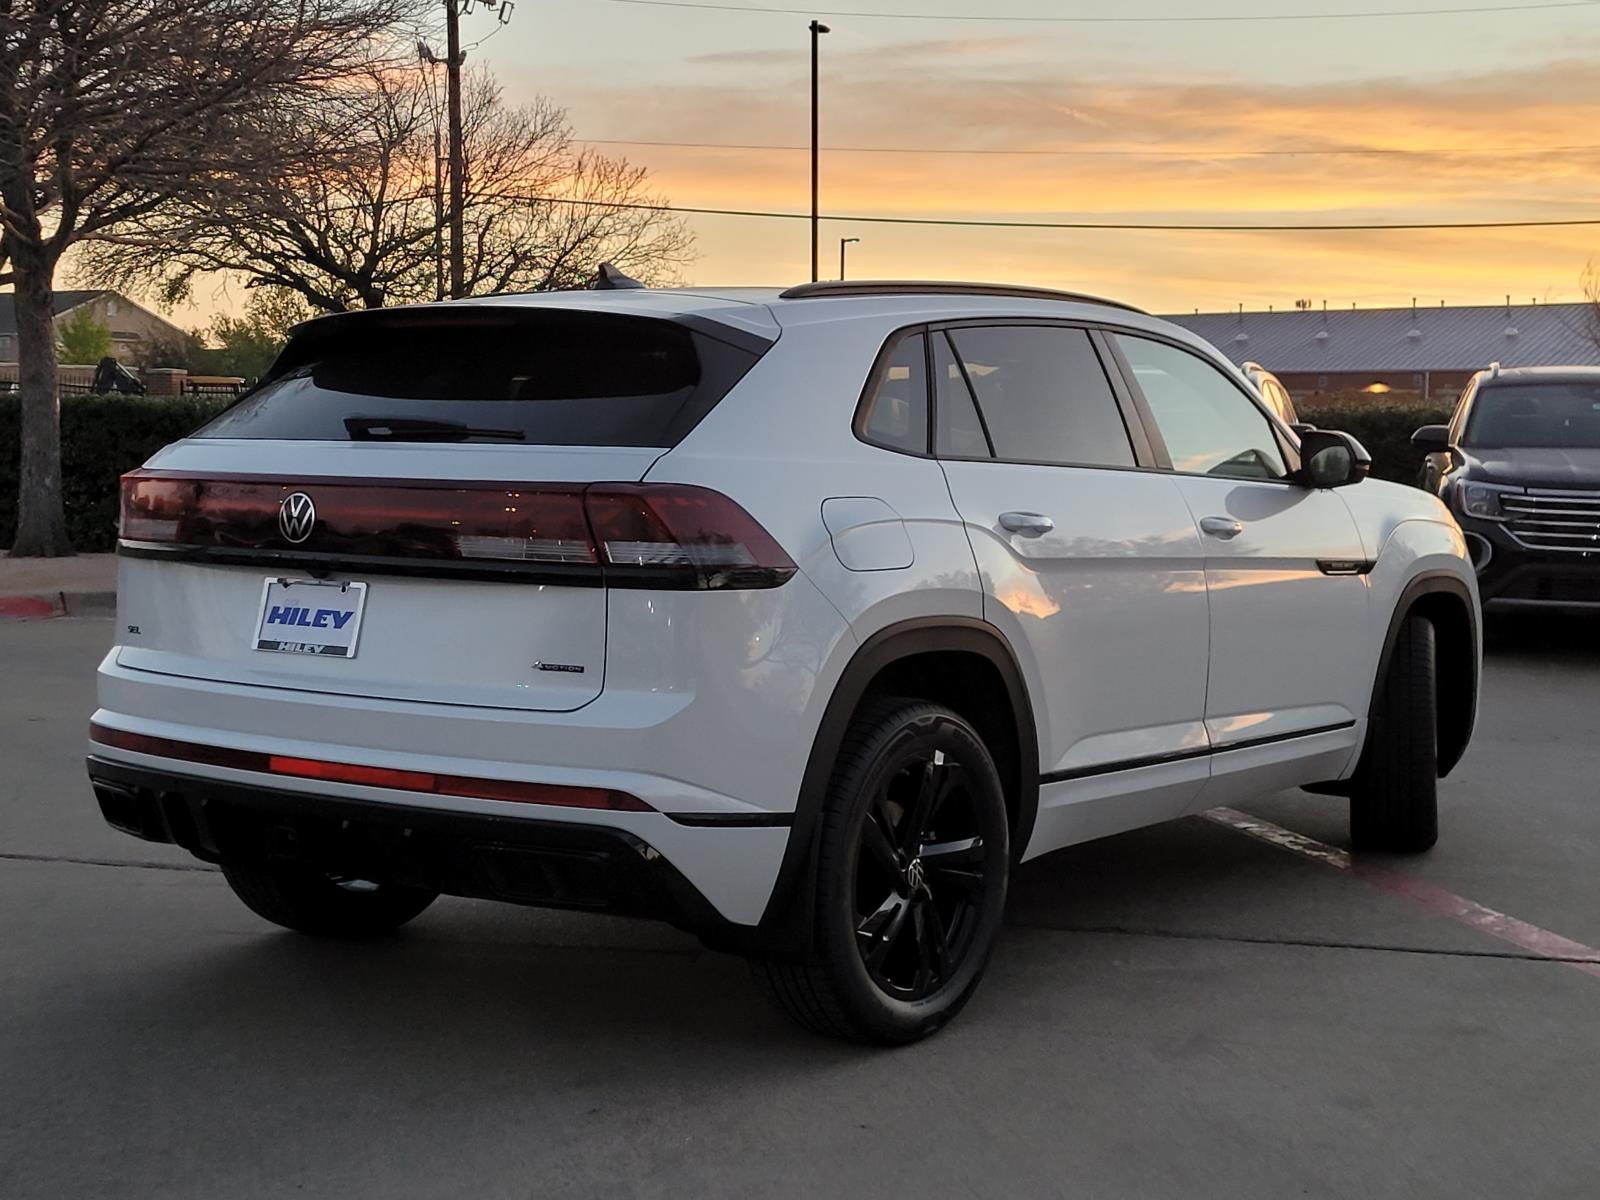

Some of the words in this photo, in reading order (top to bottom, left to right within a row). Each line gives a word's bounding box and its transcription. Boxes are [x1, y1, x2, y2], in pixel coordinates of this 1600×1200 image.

[280, 493, 314, 542] VW
[267, 606, 354, 629] HILEY
[278, 641, 324, 654] HILEY
